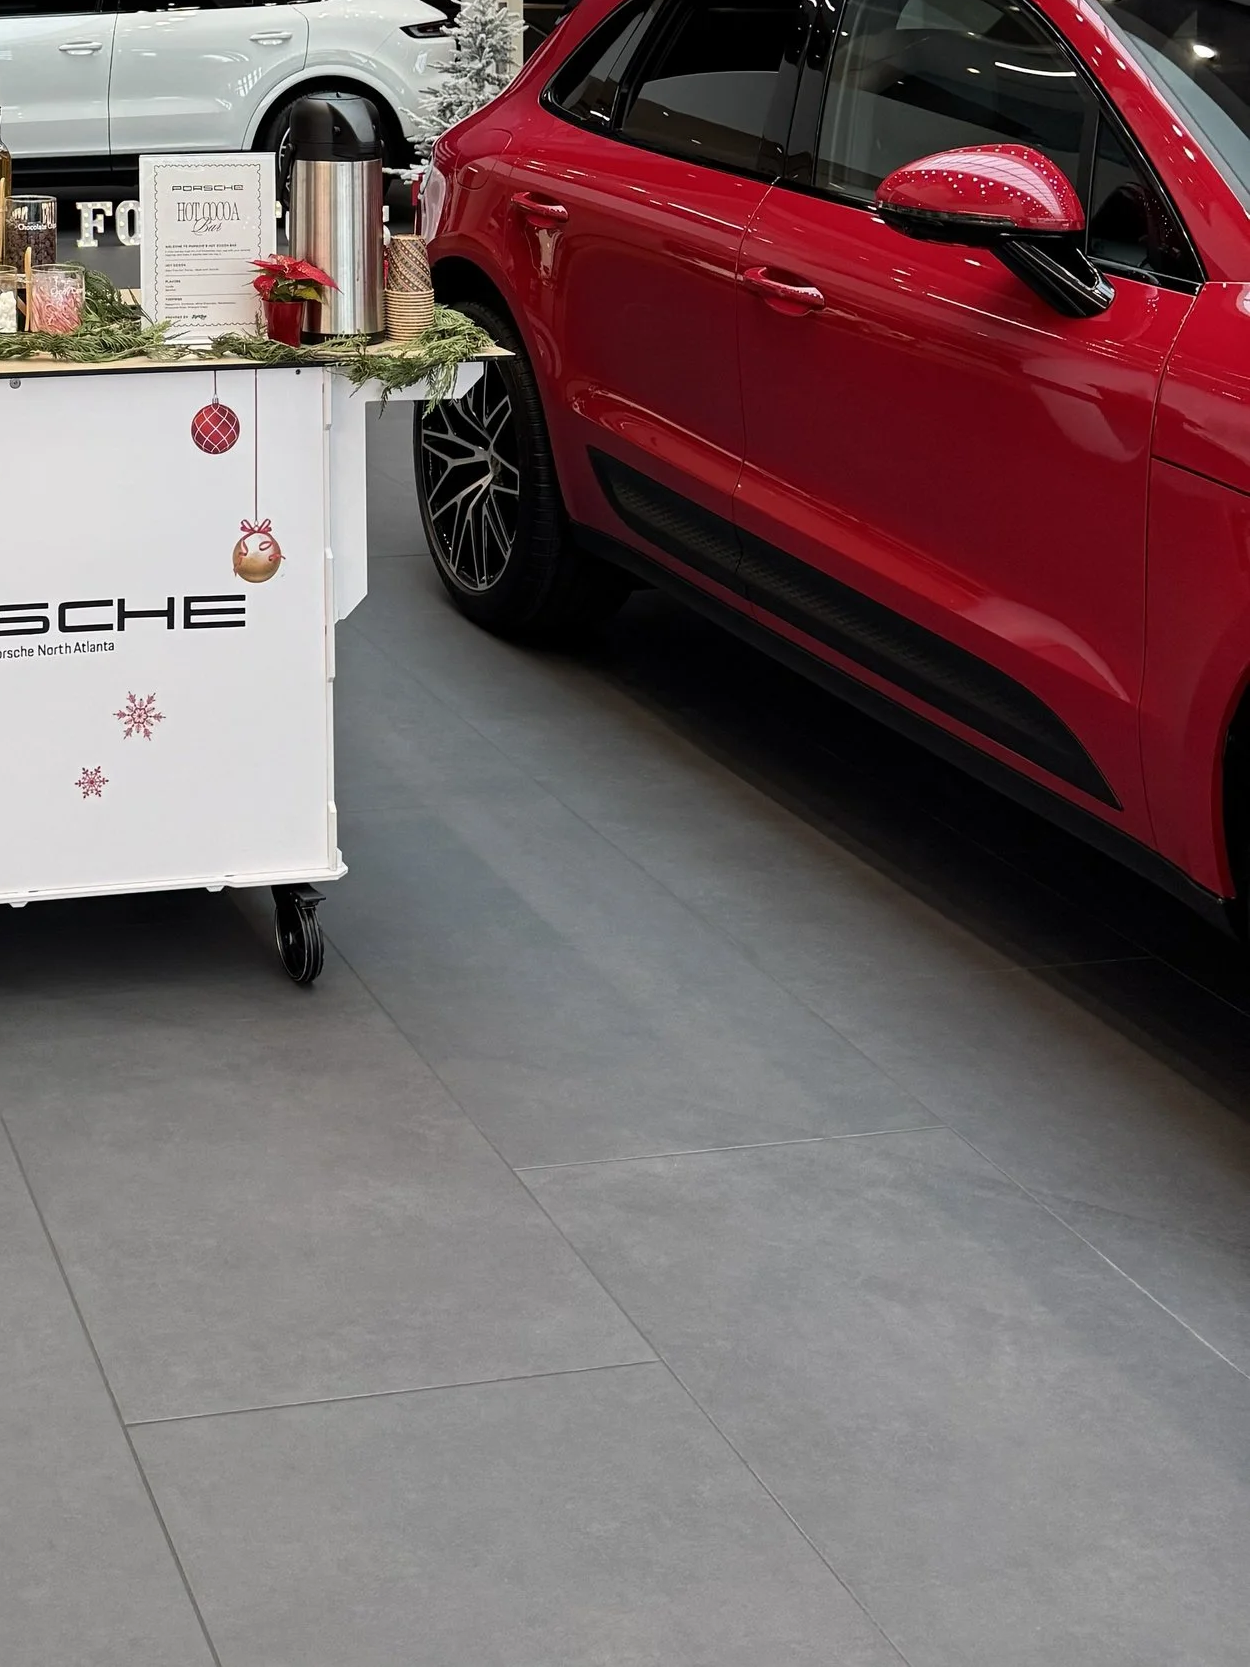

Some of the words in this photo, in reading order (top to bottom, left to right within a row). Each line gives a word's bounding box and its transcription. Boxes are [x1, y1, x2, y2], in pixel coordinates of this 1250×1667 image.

[172, 184, 244, 192] PORSCHE
[177, 202, 200, 222] HOT
[202, 200, 241, 221] COCOA
[191, 216, 223, 236] Bar
[38, 643, 72, 655] North
[73, 641, 115, 653] Atlanta
